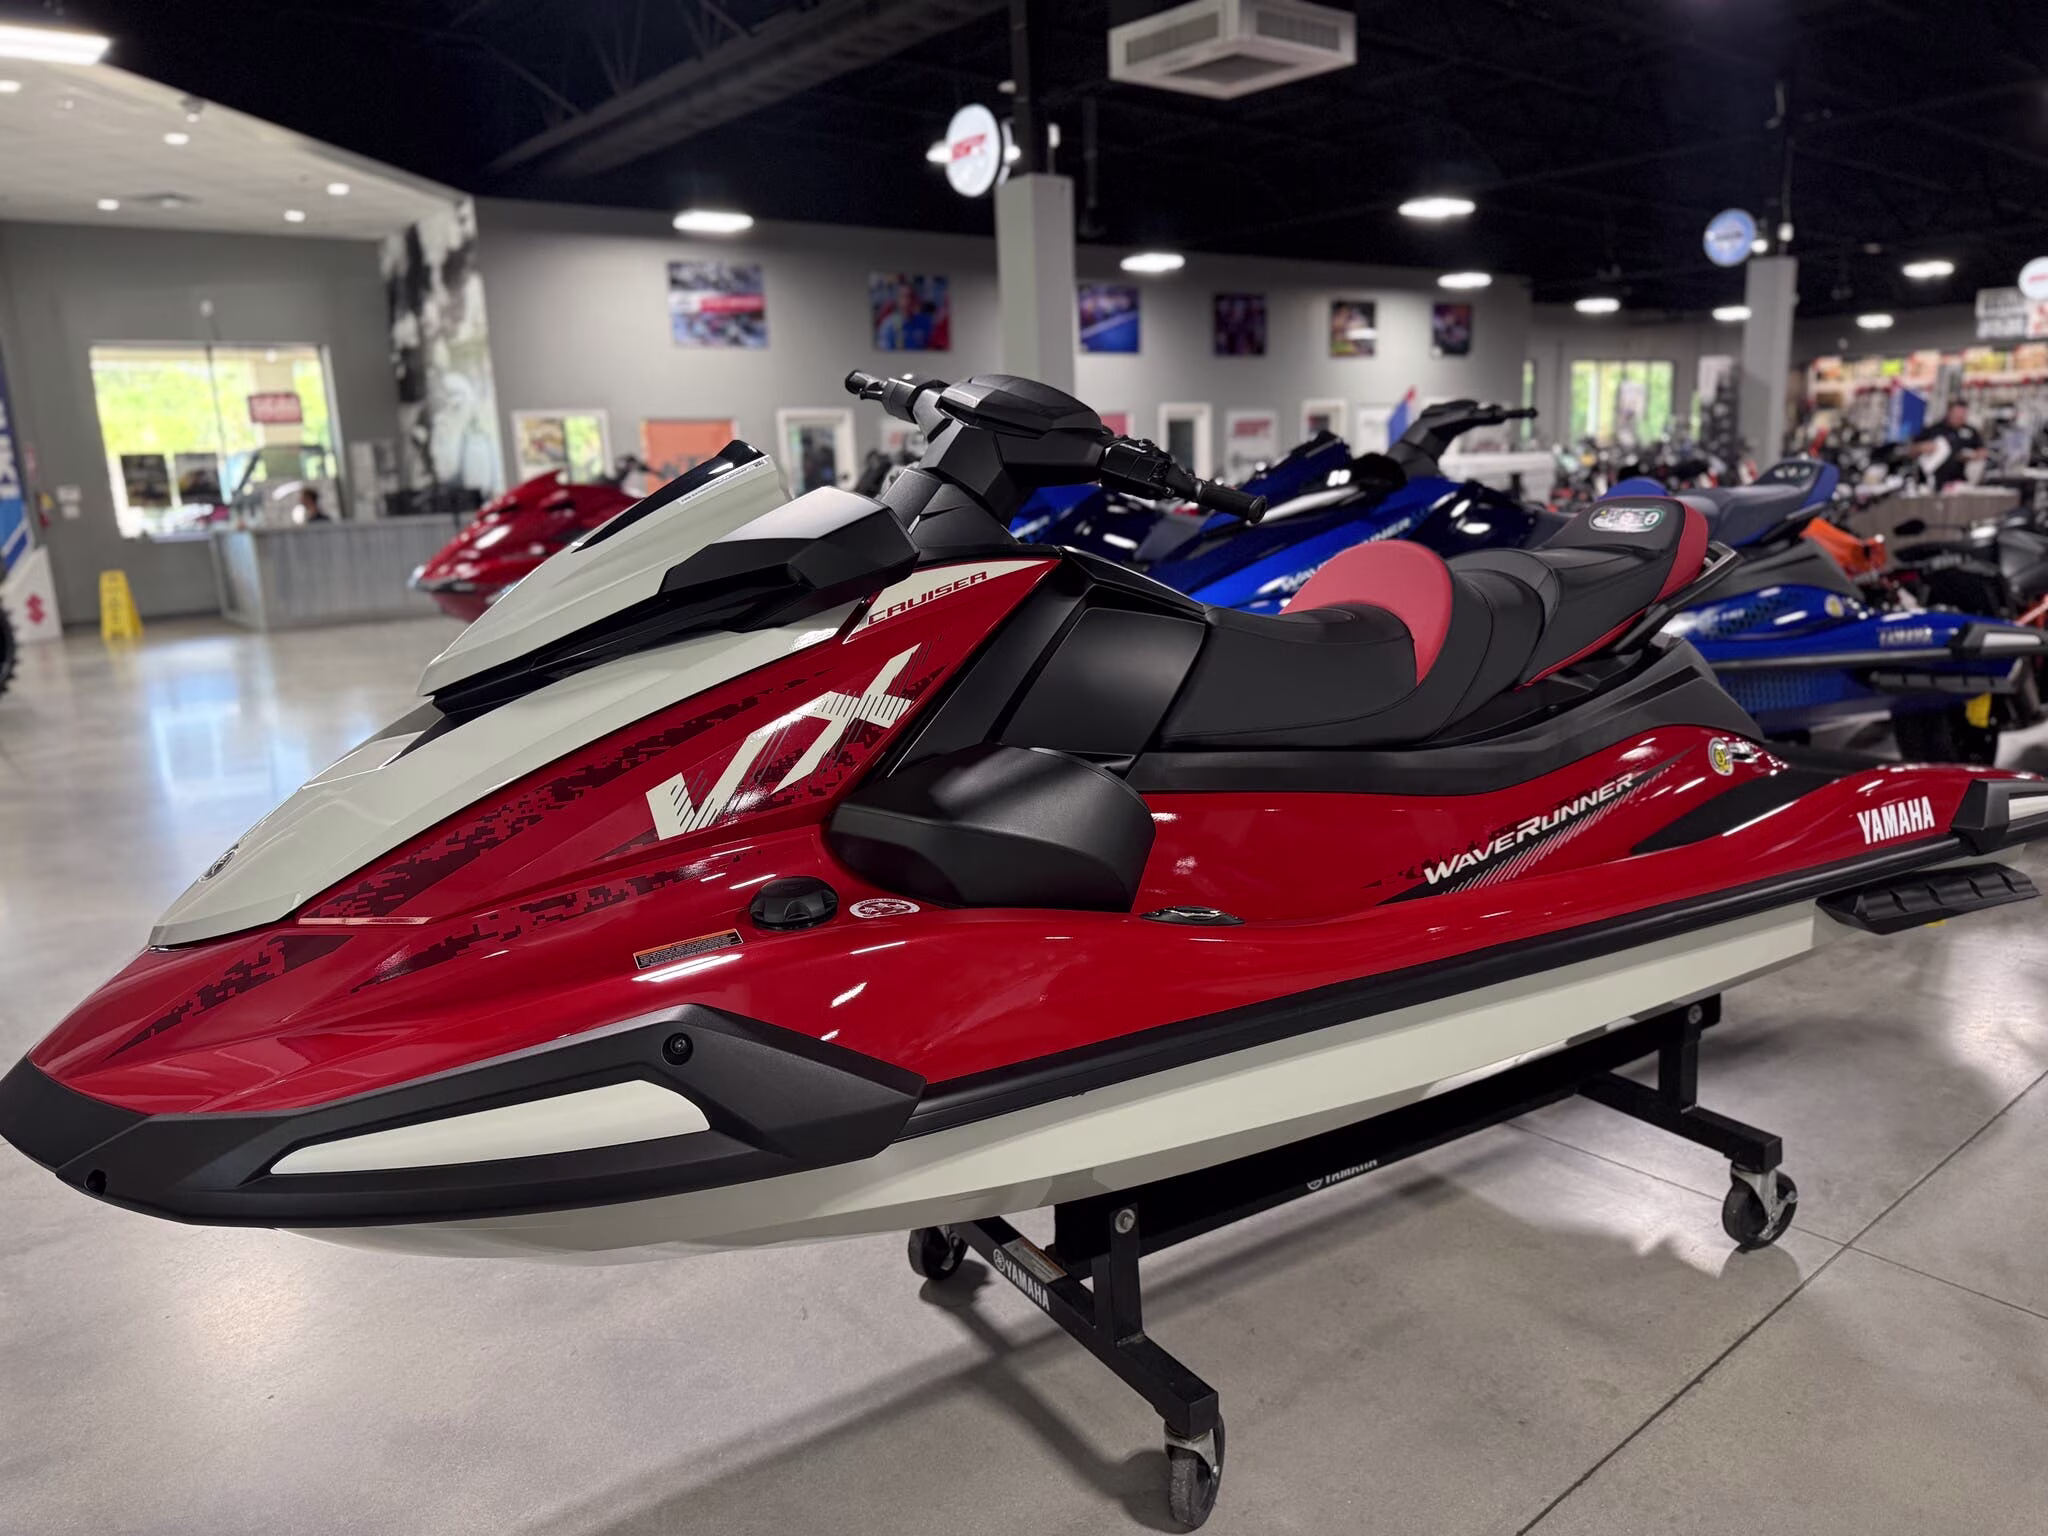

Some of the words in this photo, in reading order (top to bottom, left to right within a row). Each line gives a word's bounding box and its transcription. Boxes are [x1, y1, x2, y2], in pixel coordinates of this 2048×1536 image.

[868, 571, 988, 625] CRUISER
[645, 642, 921, 841] VX
[1423, 773, 1633, 885] WAVERUNNER
[1856, 795, 1936, 845] YAMAHA
[1005, 1259, 1050, 1312] YAMAHA
